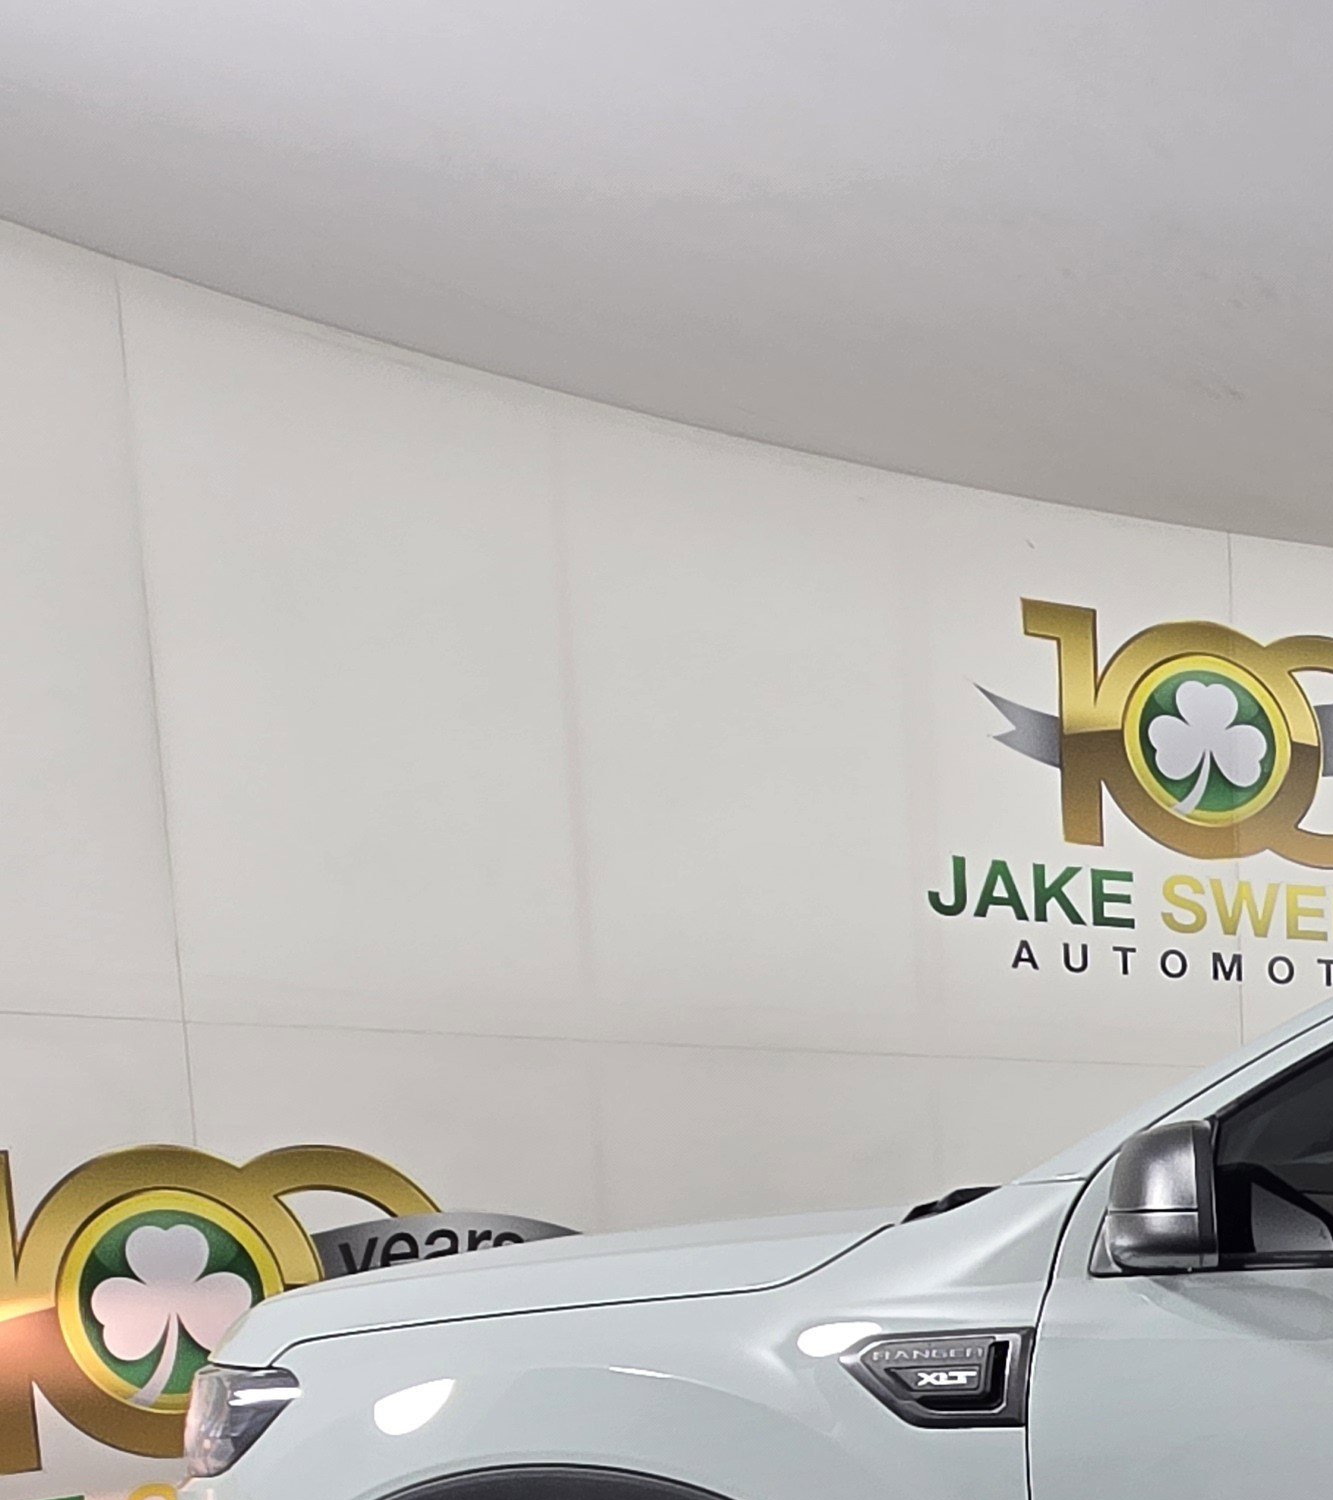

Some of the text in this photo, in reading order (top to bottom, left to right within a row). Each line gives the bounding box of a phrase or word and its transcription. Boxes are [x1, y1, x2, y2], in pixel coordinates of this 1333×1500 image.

[926, 854, 1136, 930] JAKE
[872, 1347, 984, 1362] RANGER
[917, 1370, 978, 1386] XLT
